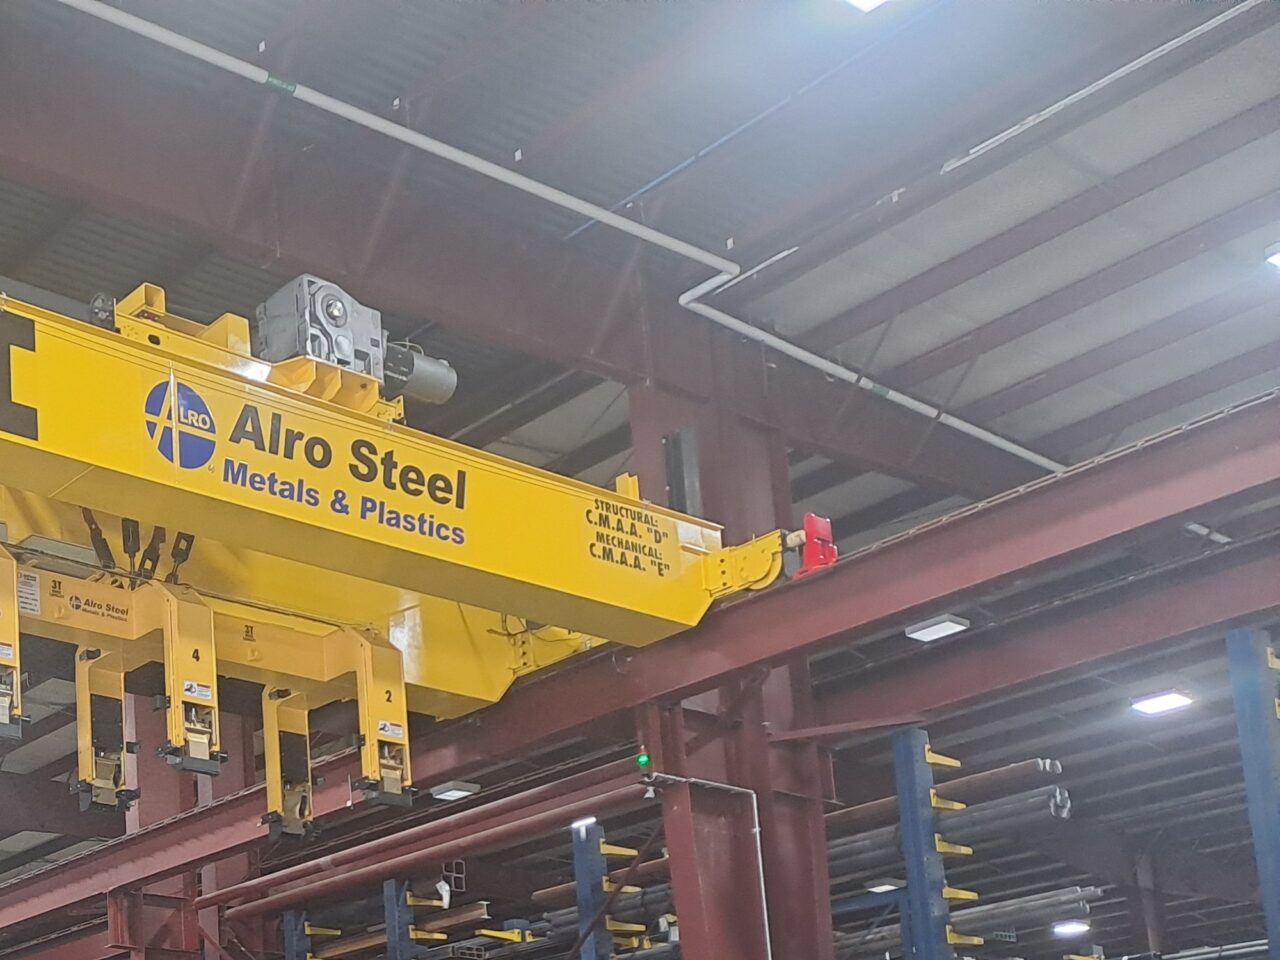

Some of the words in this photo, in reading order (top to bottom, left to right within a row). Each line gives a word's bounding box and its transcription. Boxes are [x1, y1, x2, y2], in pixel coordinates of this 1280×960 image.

[228, 403, 333, 469] Alro
[348, 439, 467, 510] Steel
[223, 458, 320, 507] Metals
[330, 489, 350, 515] &
[360, 496, 465, 545] Plastics
[594, 498, 659, 527] STRUCTURAL:
[586, 509, 642, 539] C.M.A.A.
[647, 527, 669, 544] "D"
[589, 543, 646, 571] C.M.A.A.
[650, 560, 670, 577] "E"
[596, 531, 663, 560] MECHANICAL:
[84, 599, 103, 610] Alro
[106, 603, 128, 616] Steel
[191, 648, 200, 662] 4
[384, 690, 393, 703] 2
